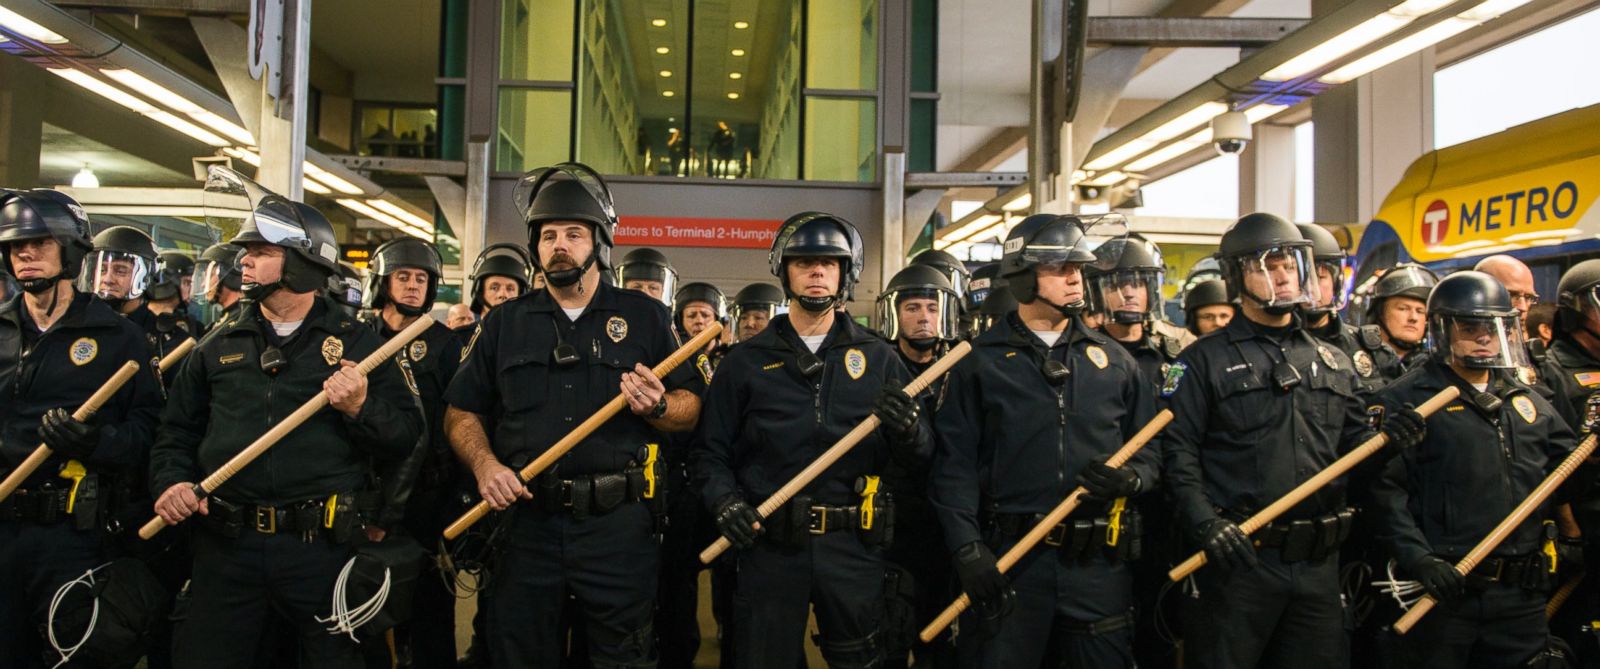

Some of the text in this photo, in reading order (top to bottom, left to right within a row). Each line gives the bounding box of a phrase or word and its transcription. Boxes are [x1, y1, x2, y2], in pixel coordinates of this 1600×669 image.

[1459, 181, 1578, 235] METRO
[652, 226, 663, 237] to
[664, 225, 715, 239] Terminal
